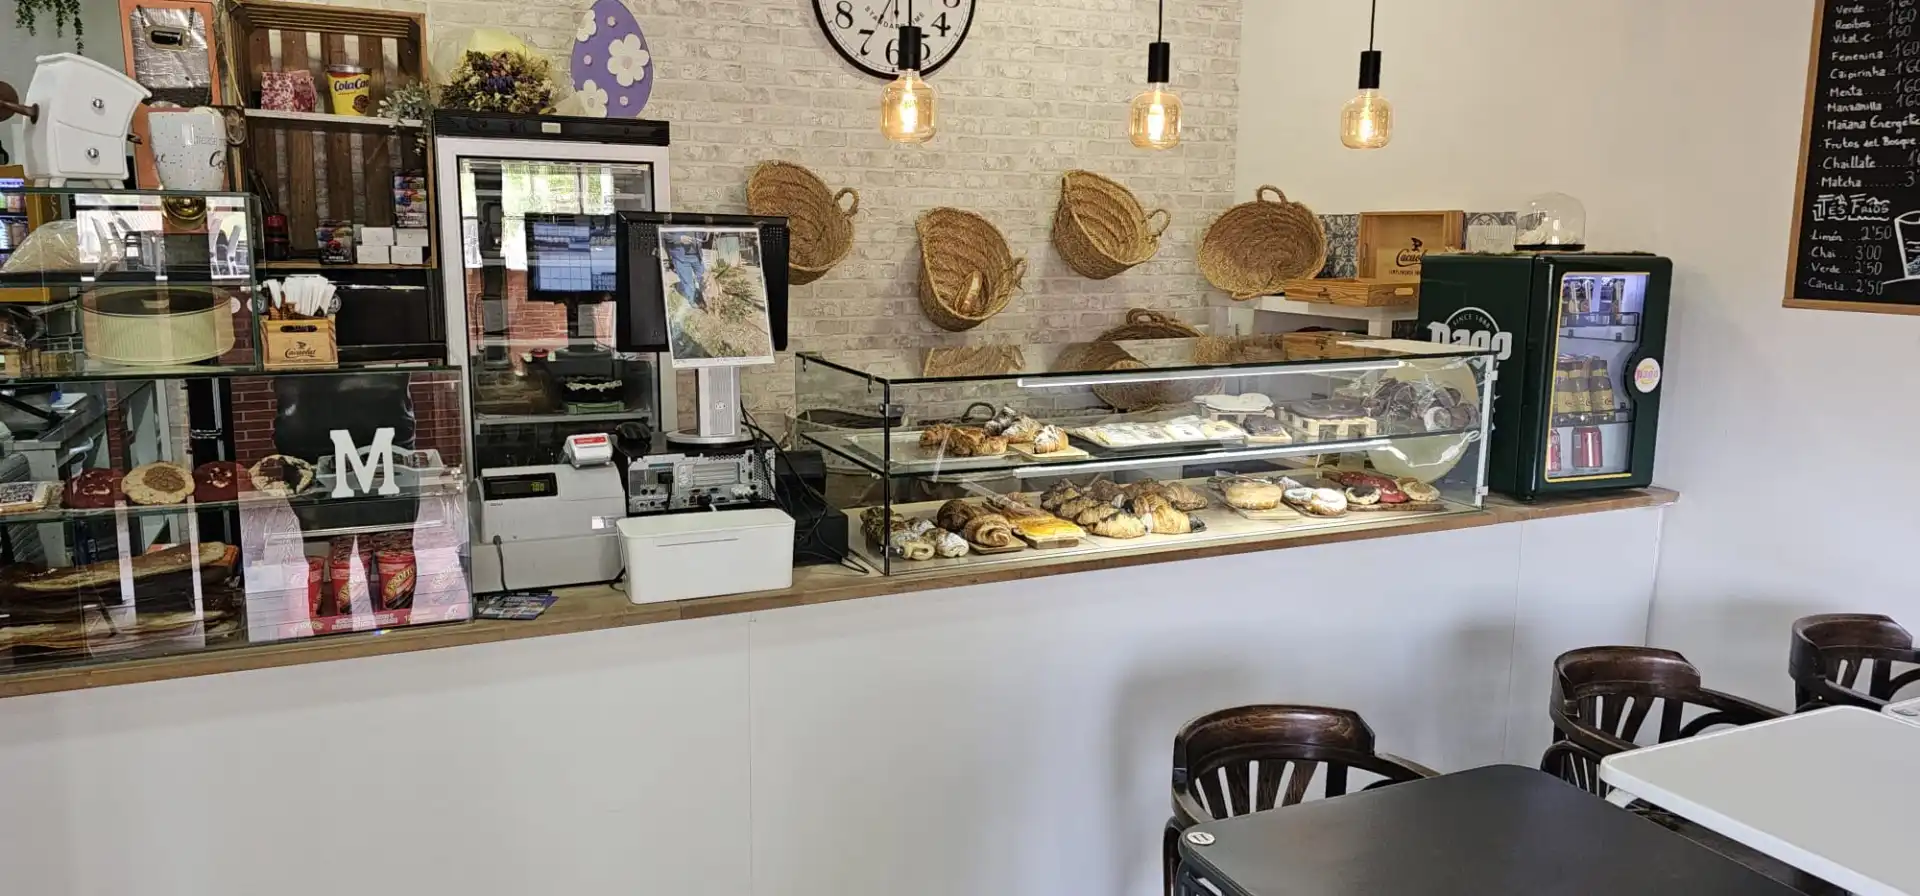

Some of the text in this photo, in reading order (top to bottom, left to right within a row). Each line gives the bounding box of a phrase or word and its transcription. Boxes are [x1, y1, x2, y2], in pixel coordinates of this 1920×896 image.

[836, 1, 853, 29] 8
[1836, 5, 1864, 14] Verde
[931, 12, 951, 37] 4
[857, 29, 875, 55] 7
[1831, 51, 1883, 61] Femenina
[1830, 66, 1886, 80] Caipirinha
[334, 78, 369, 91] ColaCao
[1830, 85, 1863, 97] Menta
[1827, 102, 1882, 112] Manzanilla
[1825, 138, 1860, 149] Frutos
[1882, 136, 1917, 149] Bosque
[1823, 154, 1876, 169] Chaillate
[1821, 176, 1862, 187] Matcha
[1811, 229, 1843, 241] Limón
[1811, 246, 1836, 258] Chai
[1811, 262, 1840, 273] Verde
[330, 427, 399, 498] M
